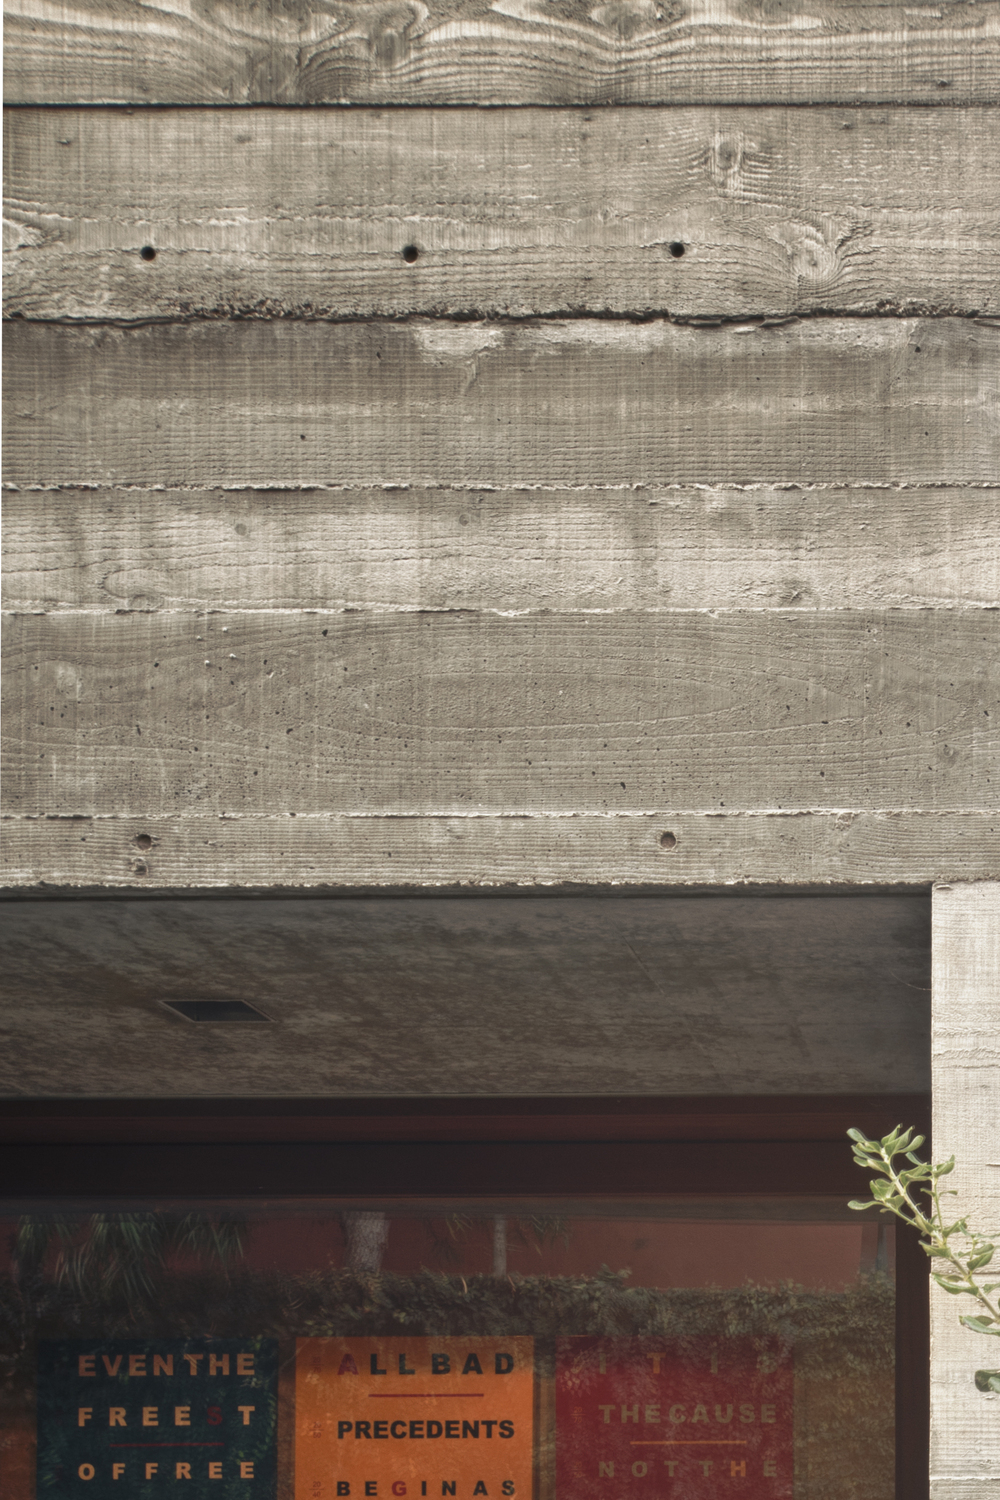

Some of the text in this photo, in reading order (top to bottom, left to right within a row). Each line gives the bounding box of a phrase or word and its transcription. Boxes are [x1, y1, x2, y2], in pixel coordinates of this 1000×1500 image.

[78, 1354, 174, 1377] EVEN
[183, 1353, 255, 1376] THE
[337, 1353, 514, 1376] ALL BAD
[78, 1405, 255, 1427] FREEST
[599, 1403, 777, 1425] THE CAUSE
[337, 1419, 515, 1440] PRECEDENTS
[145, 1461, 255, 1480] FREE
[599, 1459, 777, 1478] NOT THE
[336, 1479, 515, 1497] BEGIN AS
